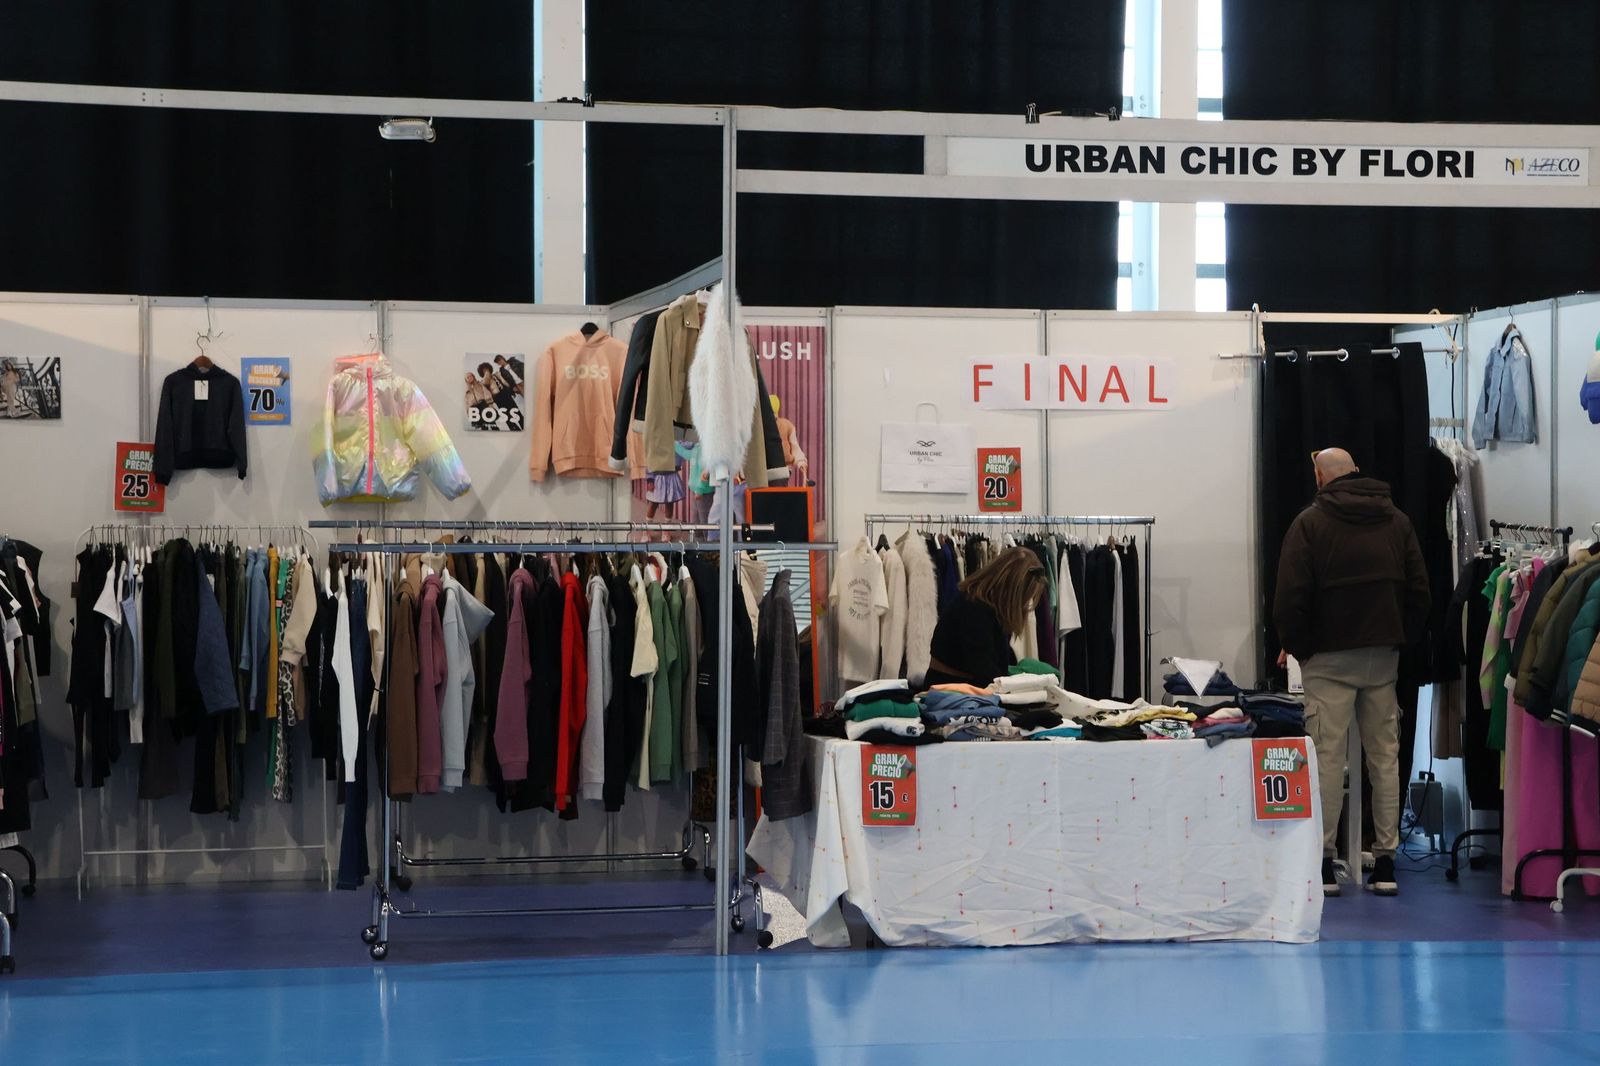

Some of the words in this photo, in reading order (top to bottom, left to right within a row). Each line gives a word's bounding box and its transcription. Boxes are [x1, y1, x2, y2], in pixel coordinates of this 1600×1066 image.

[1025, 143, 1166, 174] URBAN
[1180, 146, 1278, 176] CHIC
[1292, 148, 1347, 177] BY
[1359, 149, 1475, 179] FLORI
[756, 341, 811, 361] USH
[564, 364, 609, 380] BOSS
[973, 363, 1168, 403] FINAL
[249, 388, 275, 412] 70
[468, 406, 521, 423] BOSS
[129, 450, 151, 460] GRAN
[988, 454, 1007, 464] GRAN
[125, 459, 153, 472] PRECIO
[985, 463, 1010, 474] PRECIO
[122, 473, 150, 498] 25
[984, 476, 1009, 499] 20
[875, 754, 899, 765] GRAN
[1266, 748, 1291, 759] GRAN
[871, 764, 902, 778] PRECIO
[1264, 759, 1294, 771] PRECIO
[869, 780, 895, 810] 15
[1262, 774, 1289, 804] 10
